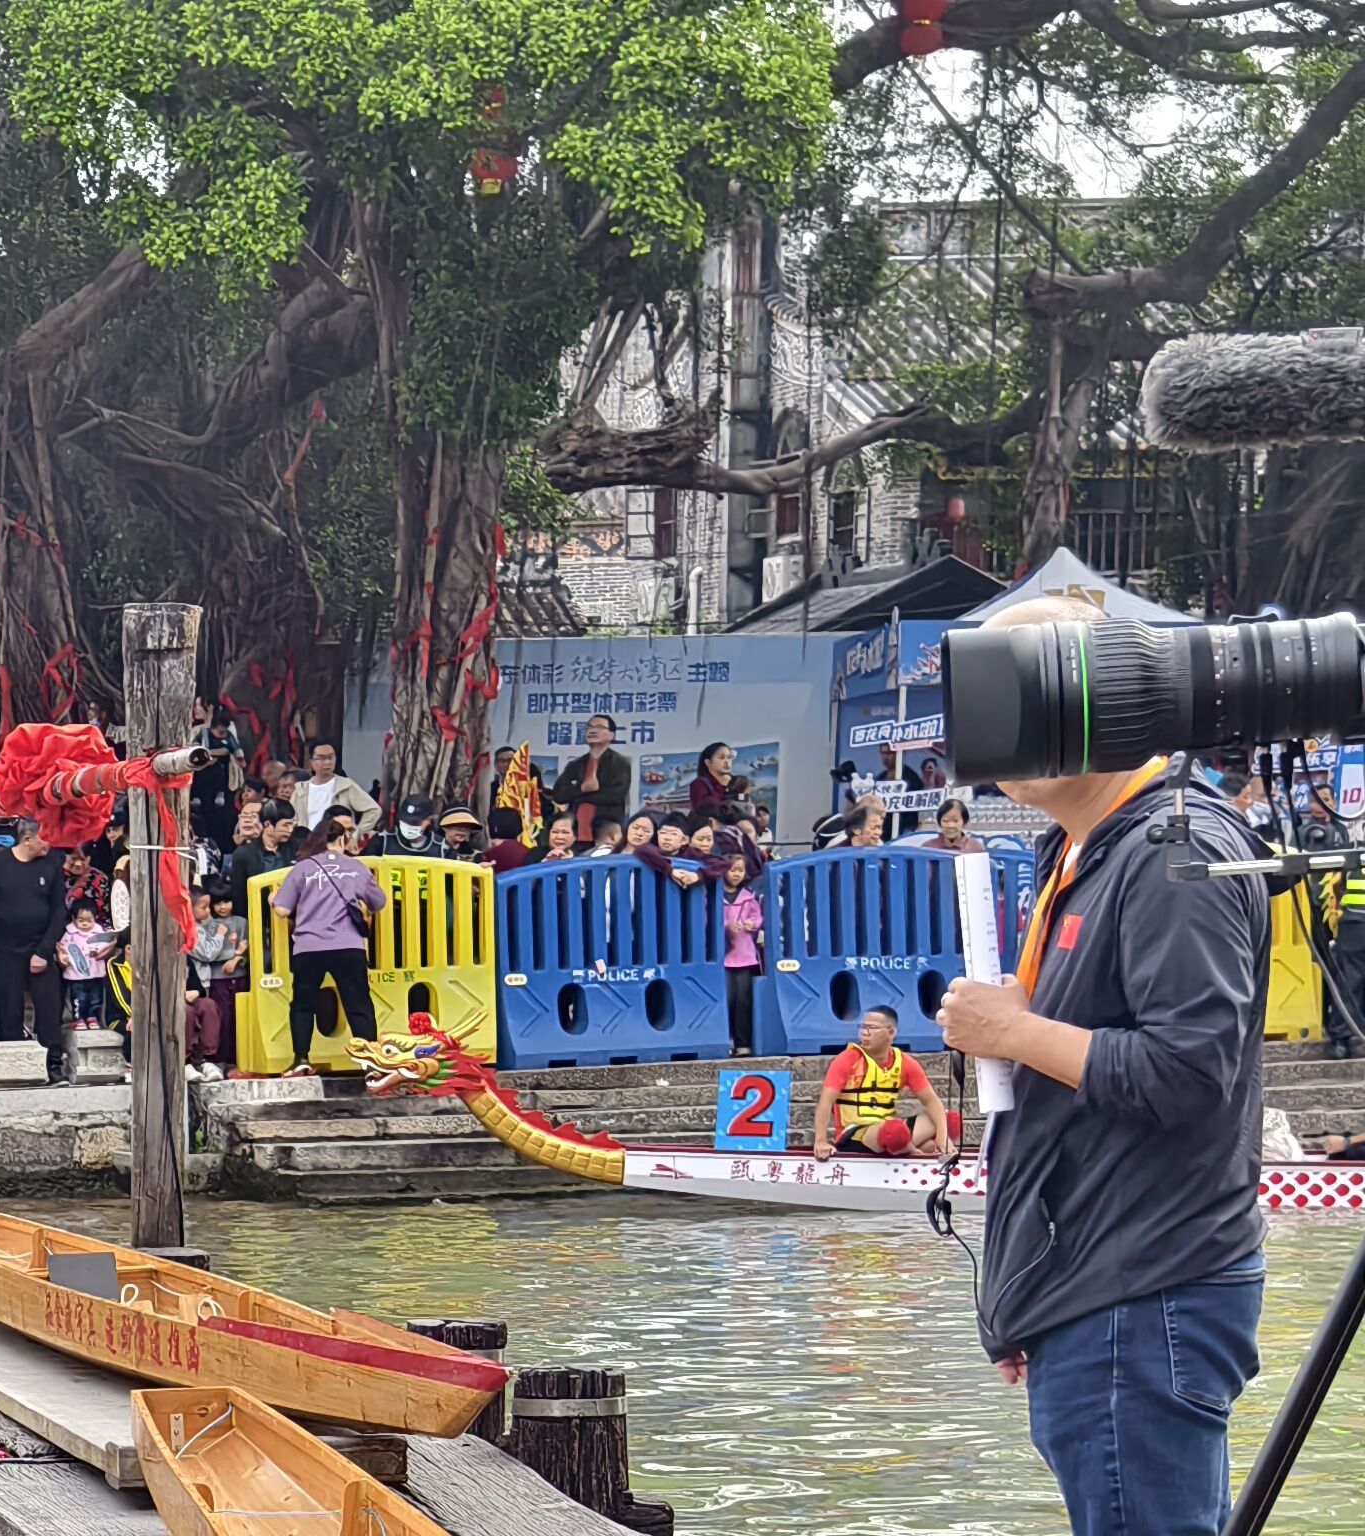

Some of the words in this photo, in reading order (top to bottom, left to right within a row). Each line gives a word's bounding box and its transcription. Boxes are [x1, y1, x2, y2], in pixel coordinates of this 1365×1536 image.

[527, 691, 677, 714] 即开型体育彩票
[855, 956, 911, 970] POLICE
[369, 971, 396, 983] LICE
[587, 968, 640, 982] POLICE
[726, 1074, 776, 1137] 2
